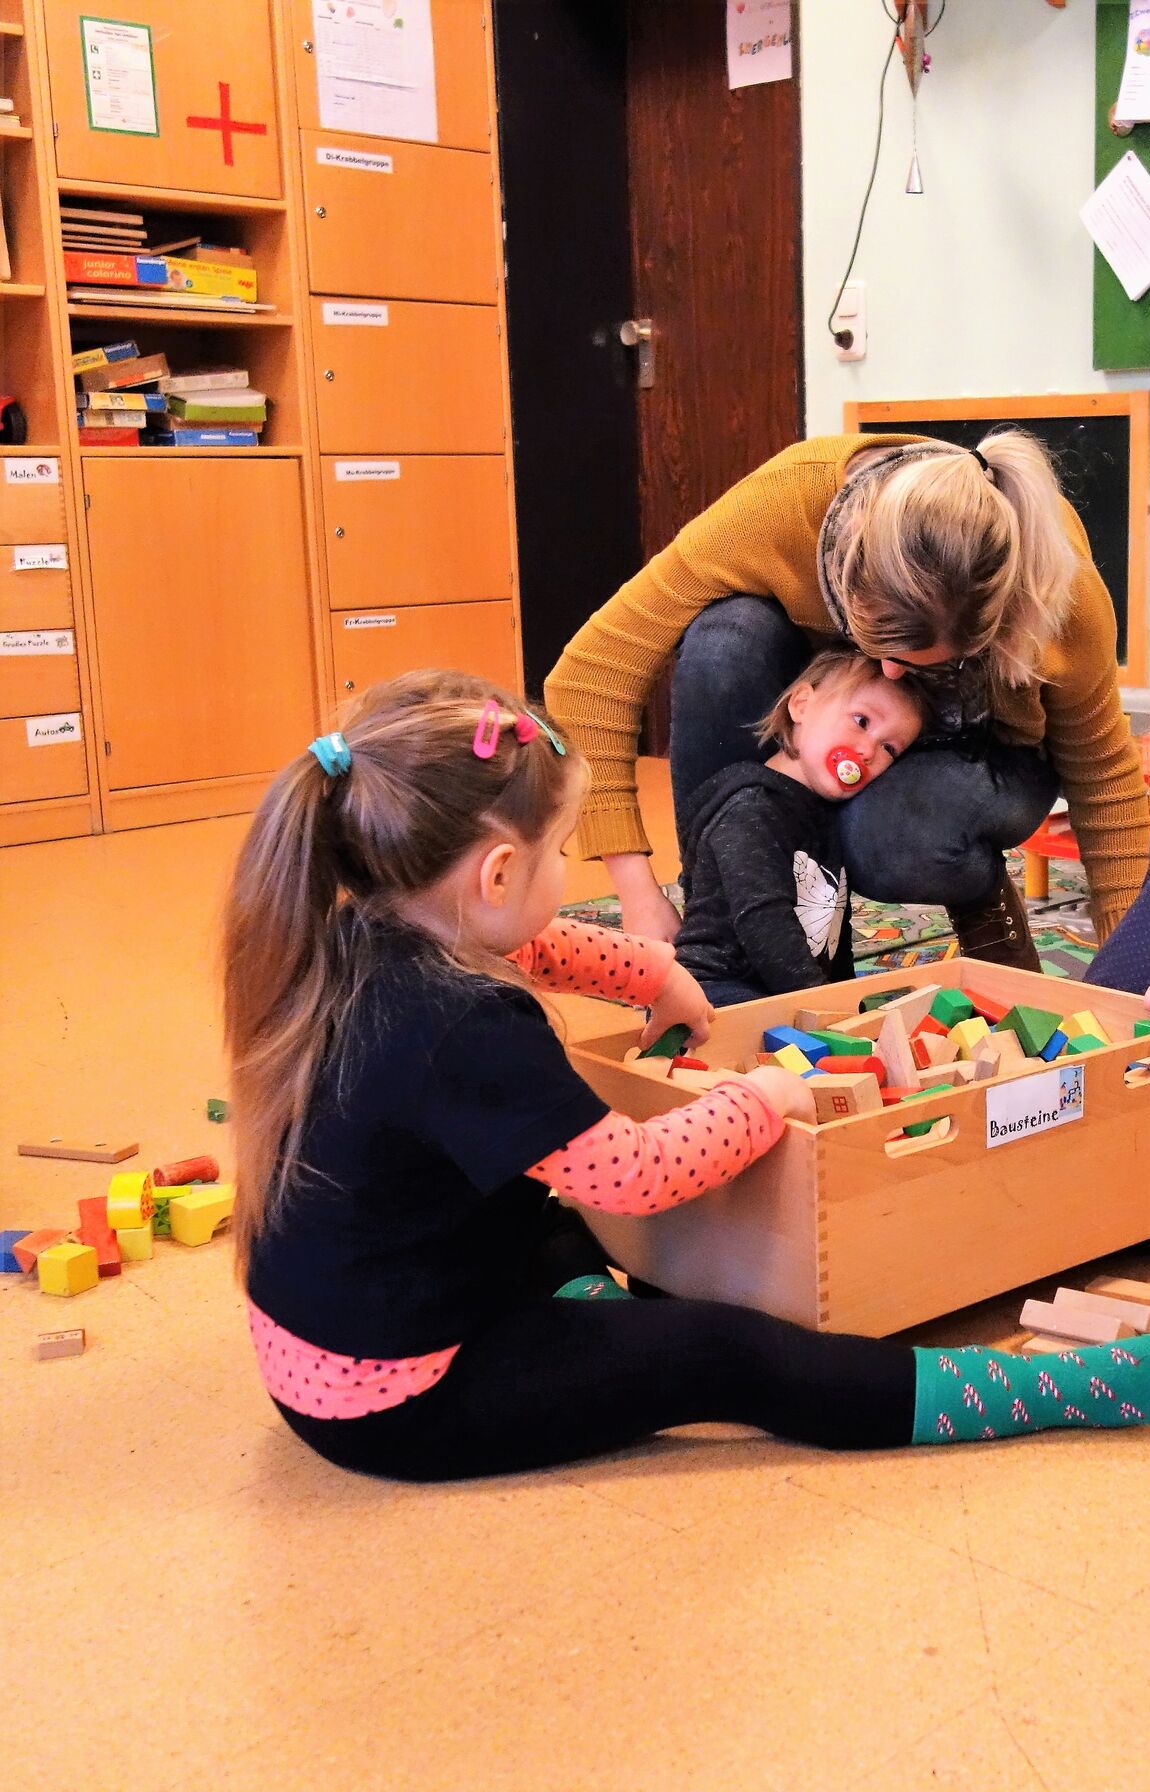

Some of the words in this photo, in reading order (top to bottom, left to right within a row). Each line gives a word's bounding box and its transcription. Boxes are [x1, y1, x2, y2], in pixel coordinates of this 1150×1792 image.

[83, 257, 116, 269] junior
[87, 269, 132, 280] colorino
[10, 469, 37, 479] Malen
[35, 729, 60, 737] Autos
[990, 1110, 1059, 1138] Bausteine
